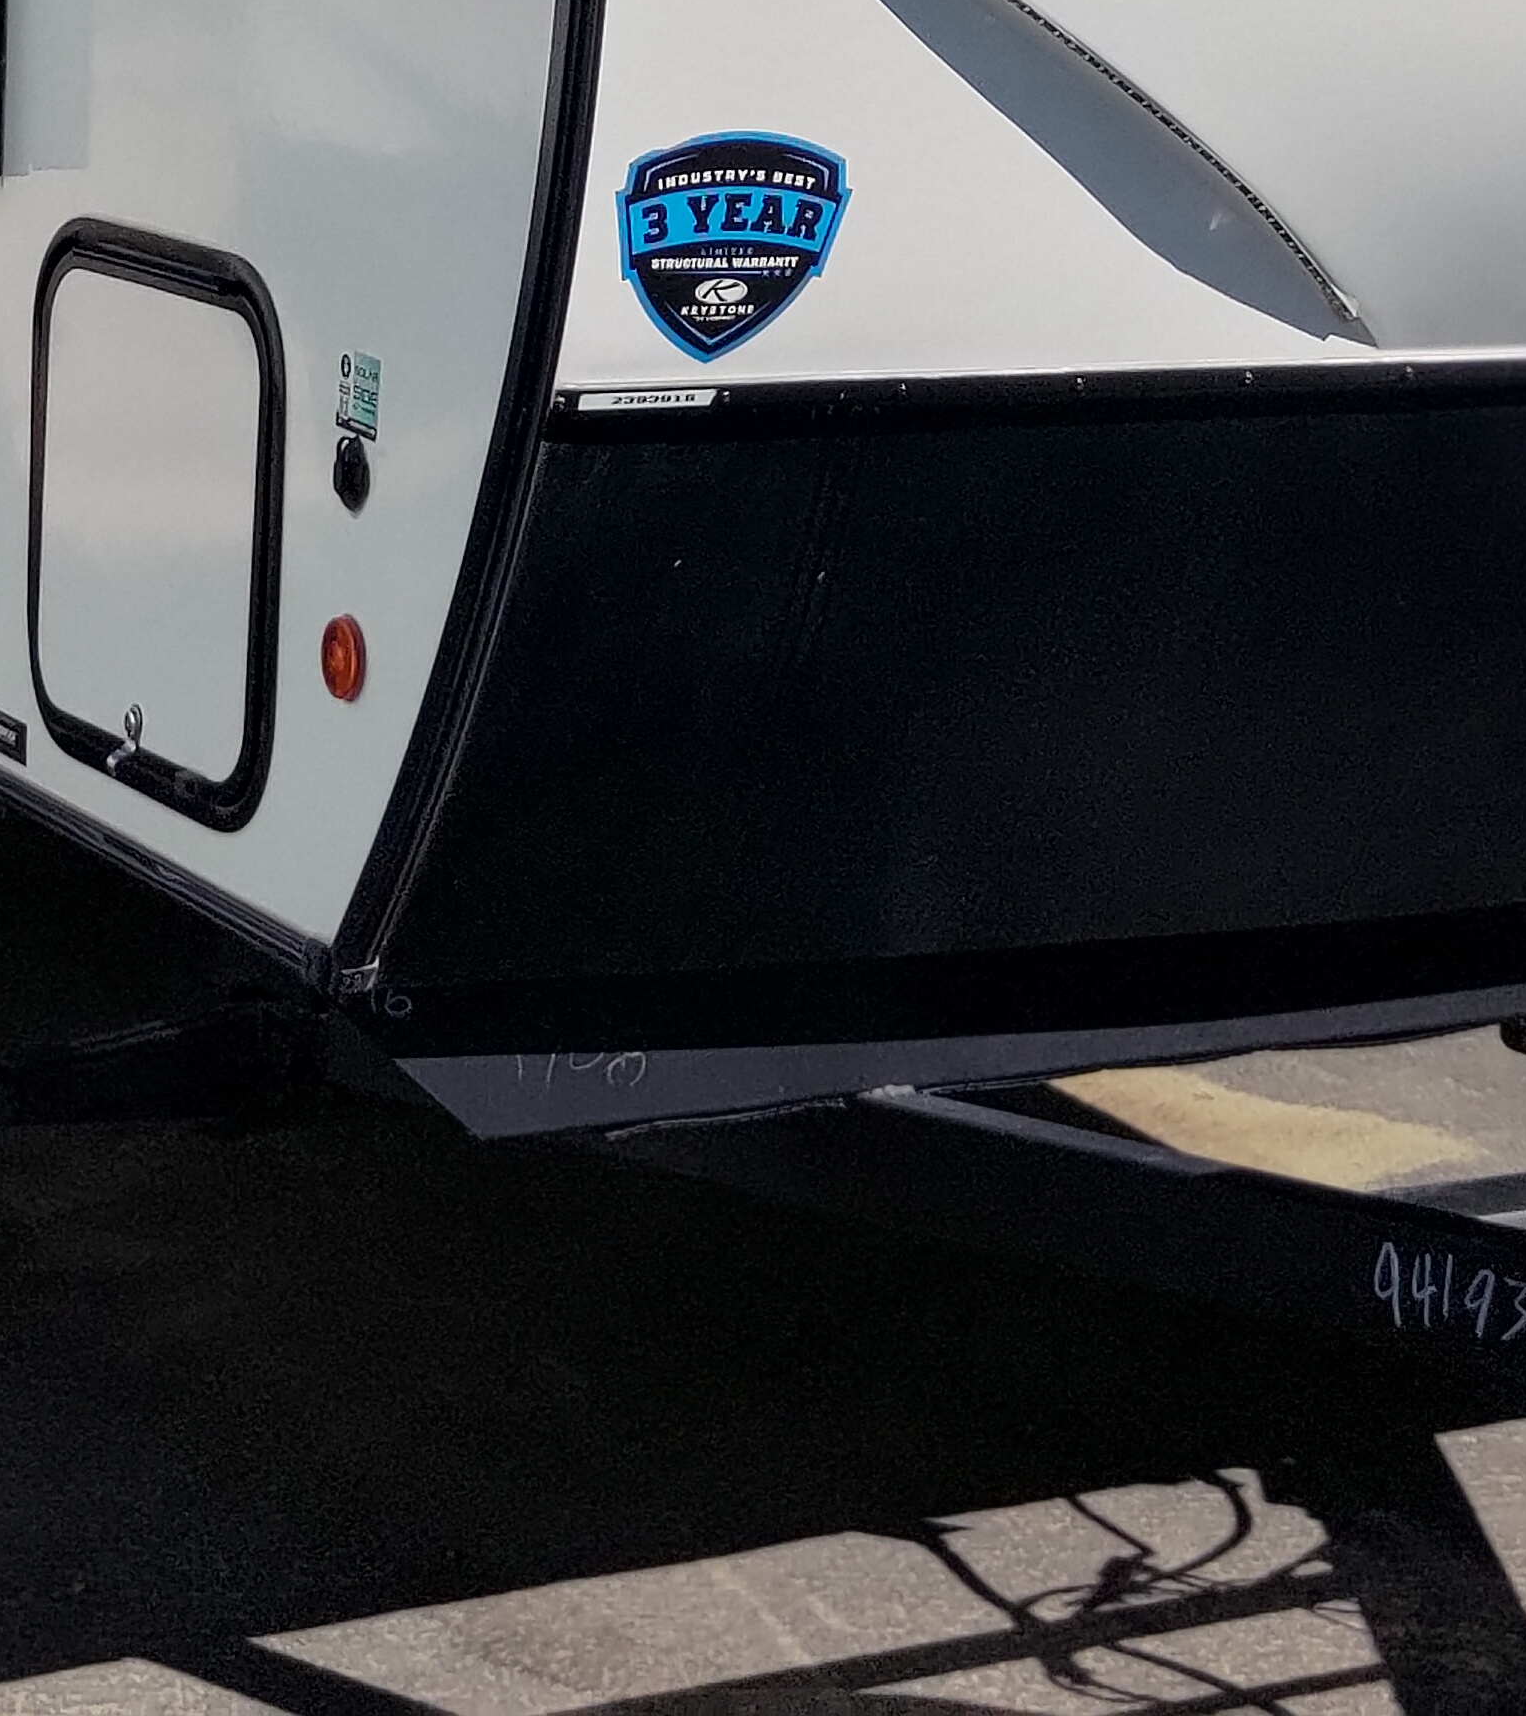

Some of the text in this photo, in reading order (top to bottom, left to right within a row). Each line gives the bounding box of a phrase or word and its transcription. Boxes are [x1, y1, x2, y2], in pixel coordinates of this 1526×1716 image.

[657, 169, 817, 191] INDUSTRY'S BEST
[642, 191, 825, 244] 3 YEAR
[651, 256, 800, 270] STRUCTURAL WARRANTY
[680, 304, 755, 316] KEYSTONE
